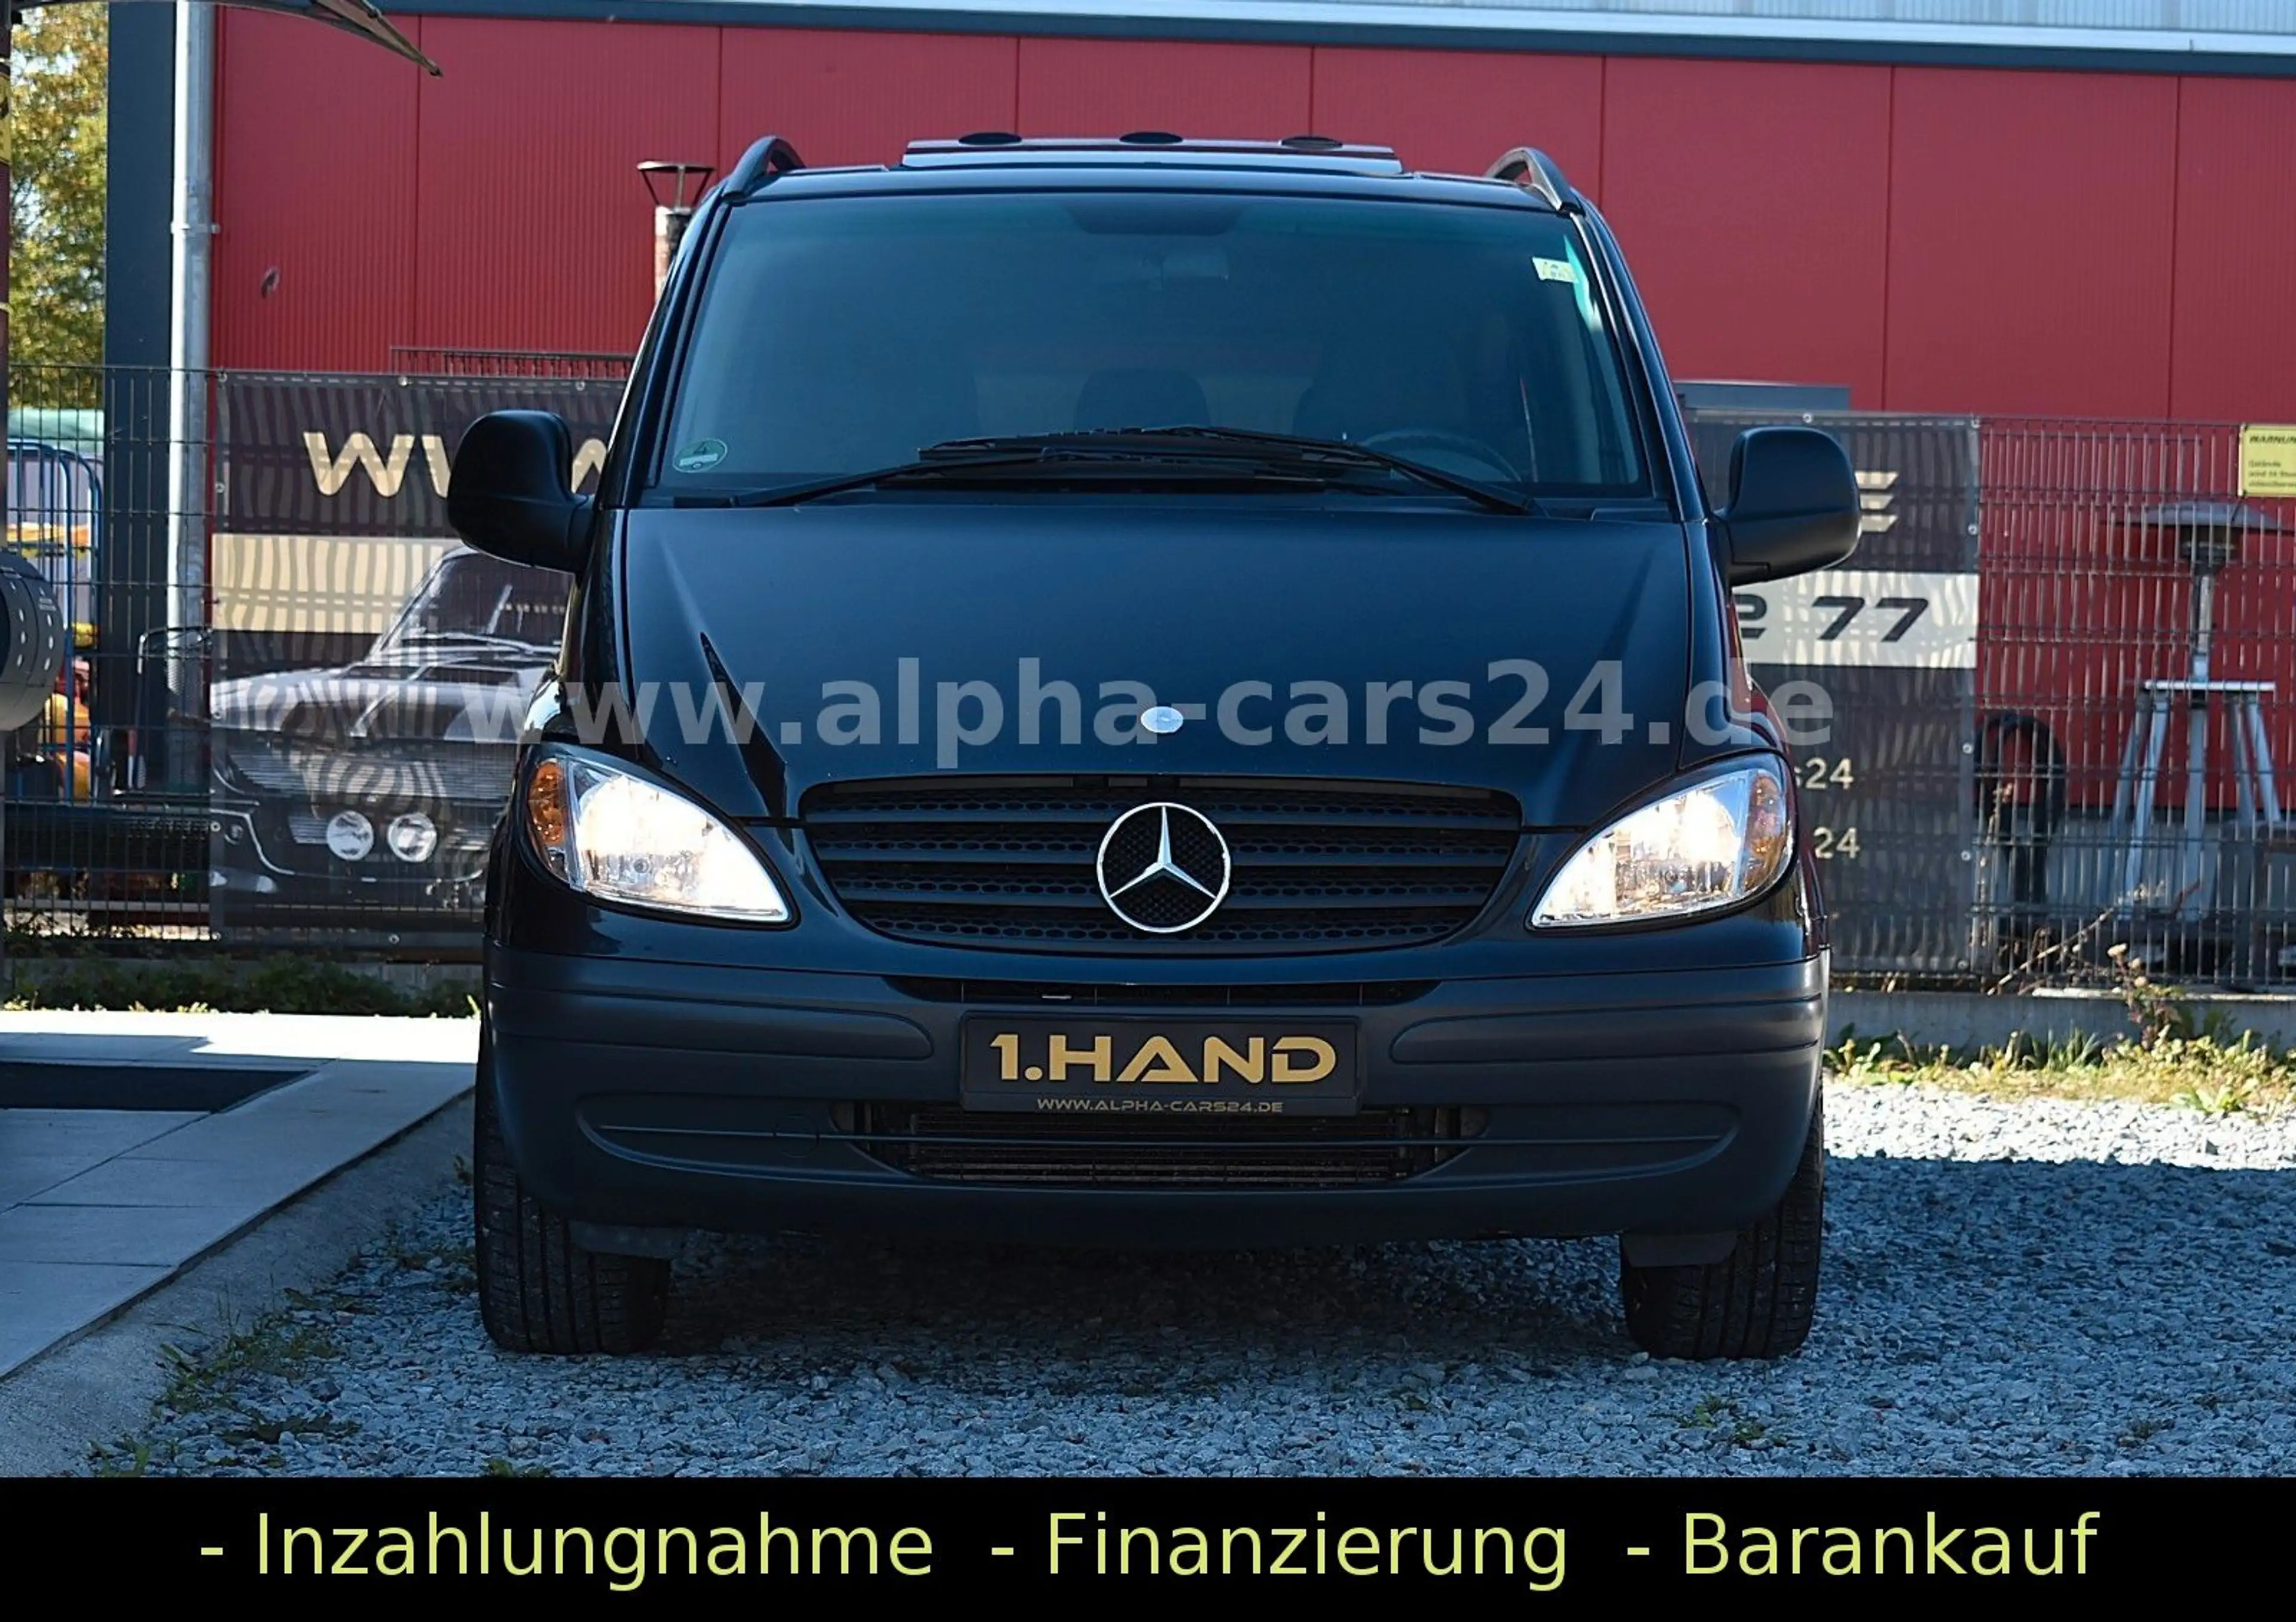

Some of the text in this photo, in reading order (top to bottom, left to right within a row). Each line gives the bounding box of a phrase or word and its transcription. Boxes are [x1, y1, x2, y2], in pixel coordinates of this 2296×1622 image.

[1812, 596, 1929, 642] 77
[1813, 827, 1861, 859] 24
[990, 1034, 1336, 1083] 1.HAND
[1037, 1098, 1284, 1113] WWW.ALPHA-CARS24.DE
